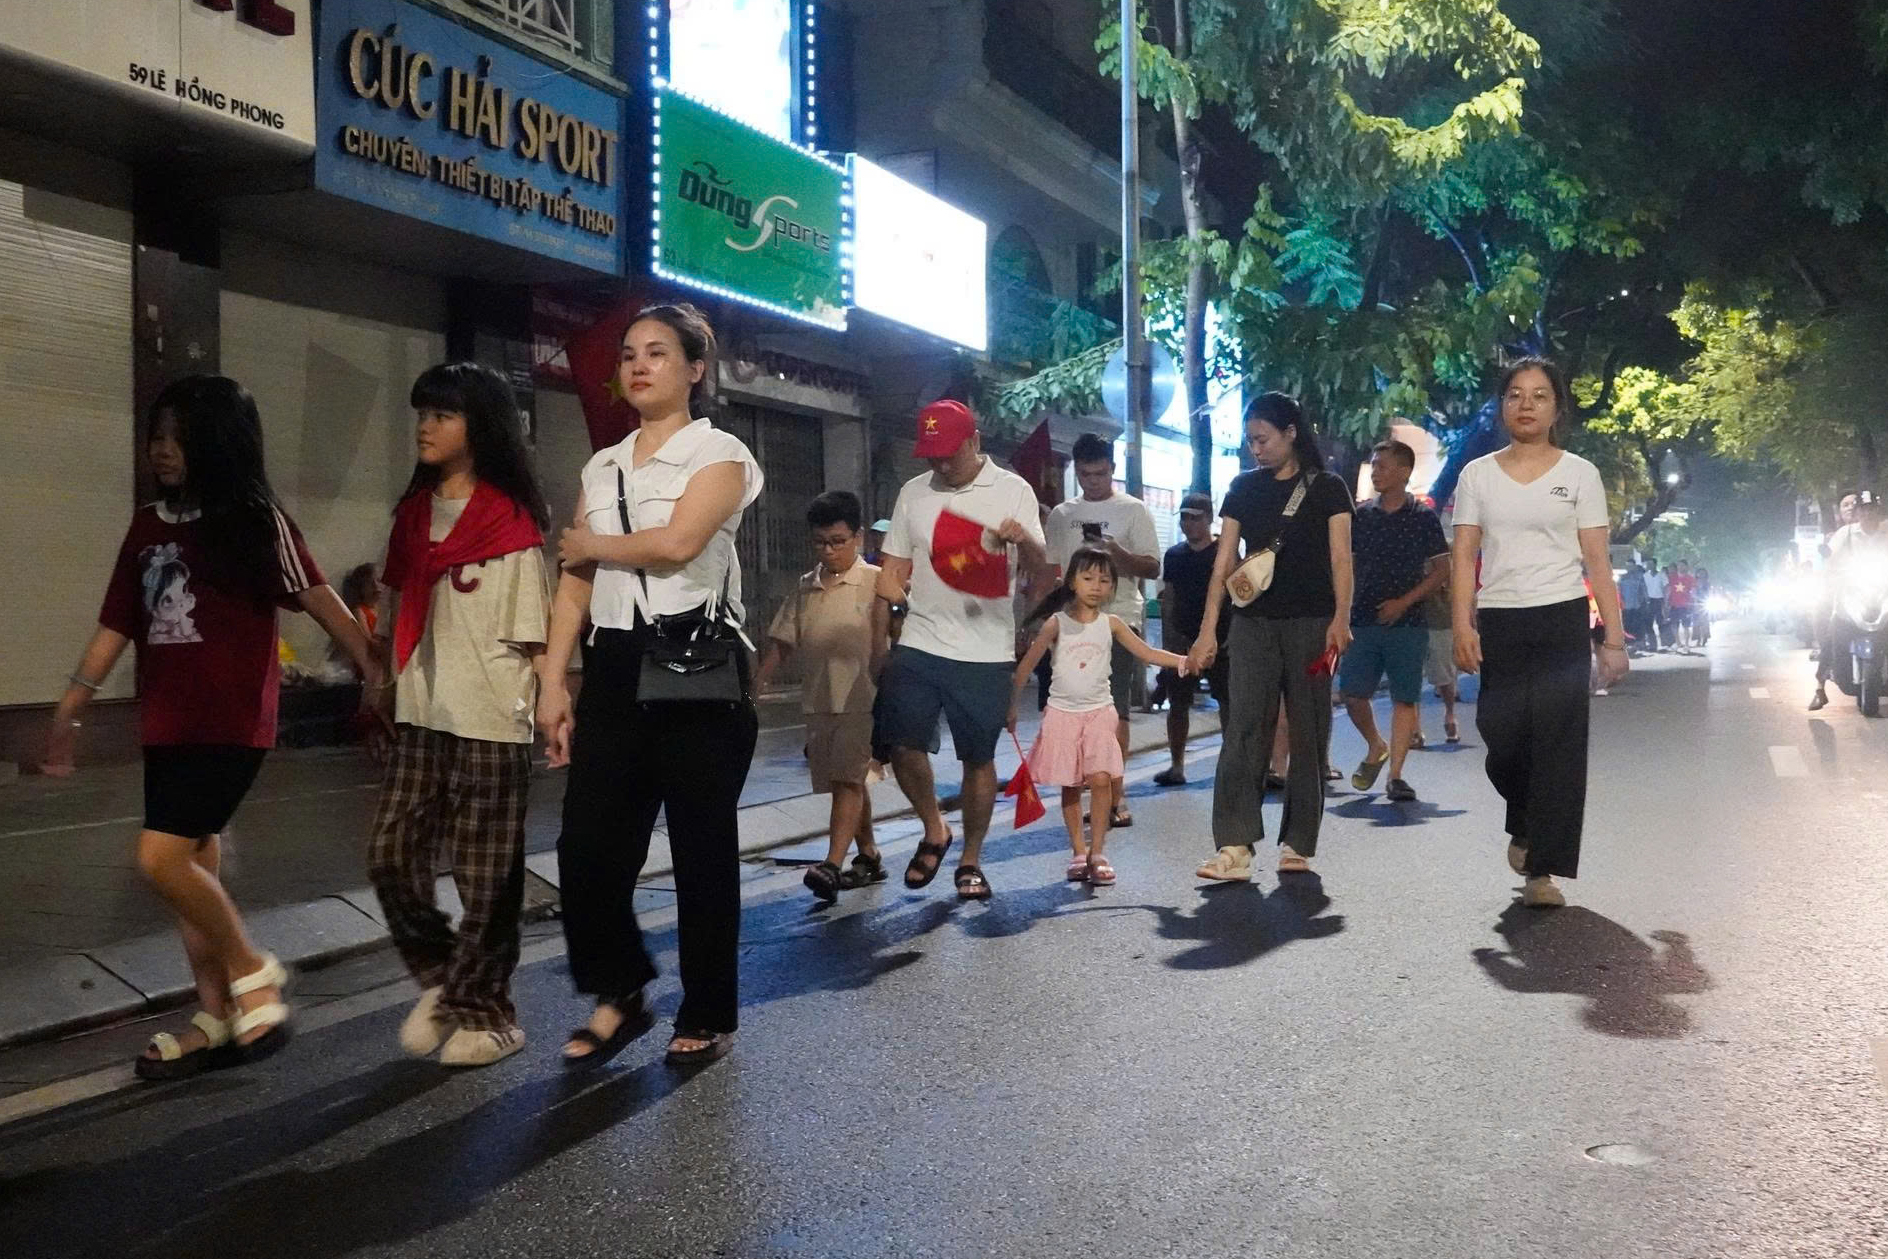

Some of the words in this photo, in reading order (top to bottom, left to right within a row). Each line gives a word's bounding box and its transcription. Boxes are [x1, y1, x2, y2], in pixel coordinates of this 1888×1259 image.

[129, 62, 148, 84] 59
[150, 69, 167, 92] LÊ
[175, 76, 226, 110] HỒNG
[231, 98, 285, 130] PHONG
[350, 24, 437, 120] CÚC
[450, 54, 514, 149] HẢI
[519, 97, 617, 188] SPORT
[577, 203, 616, 235] THAO
